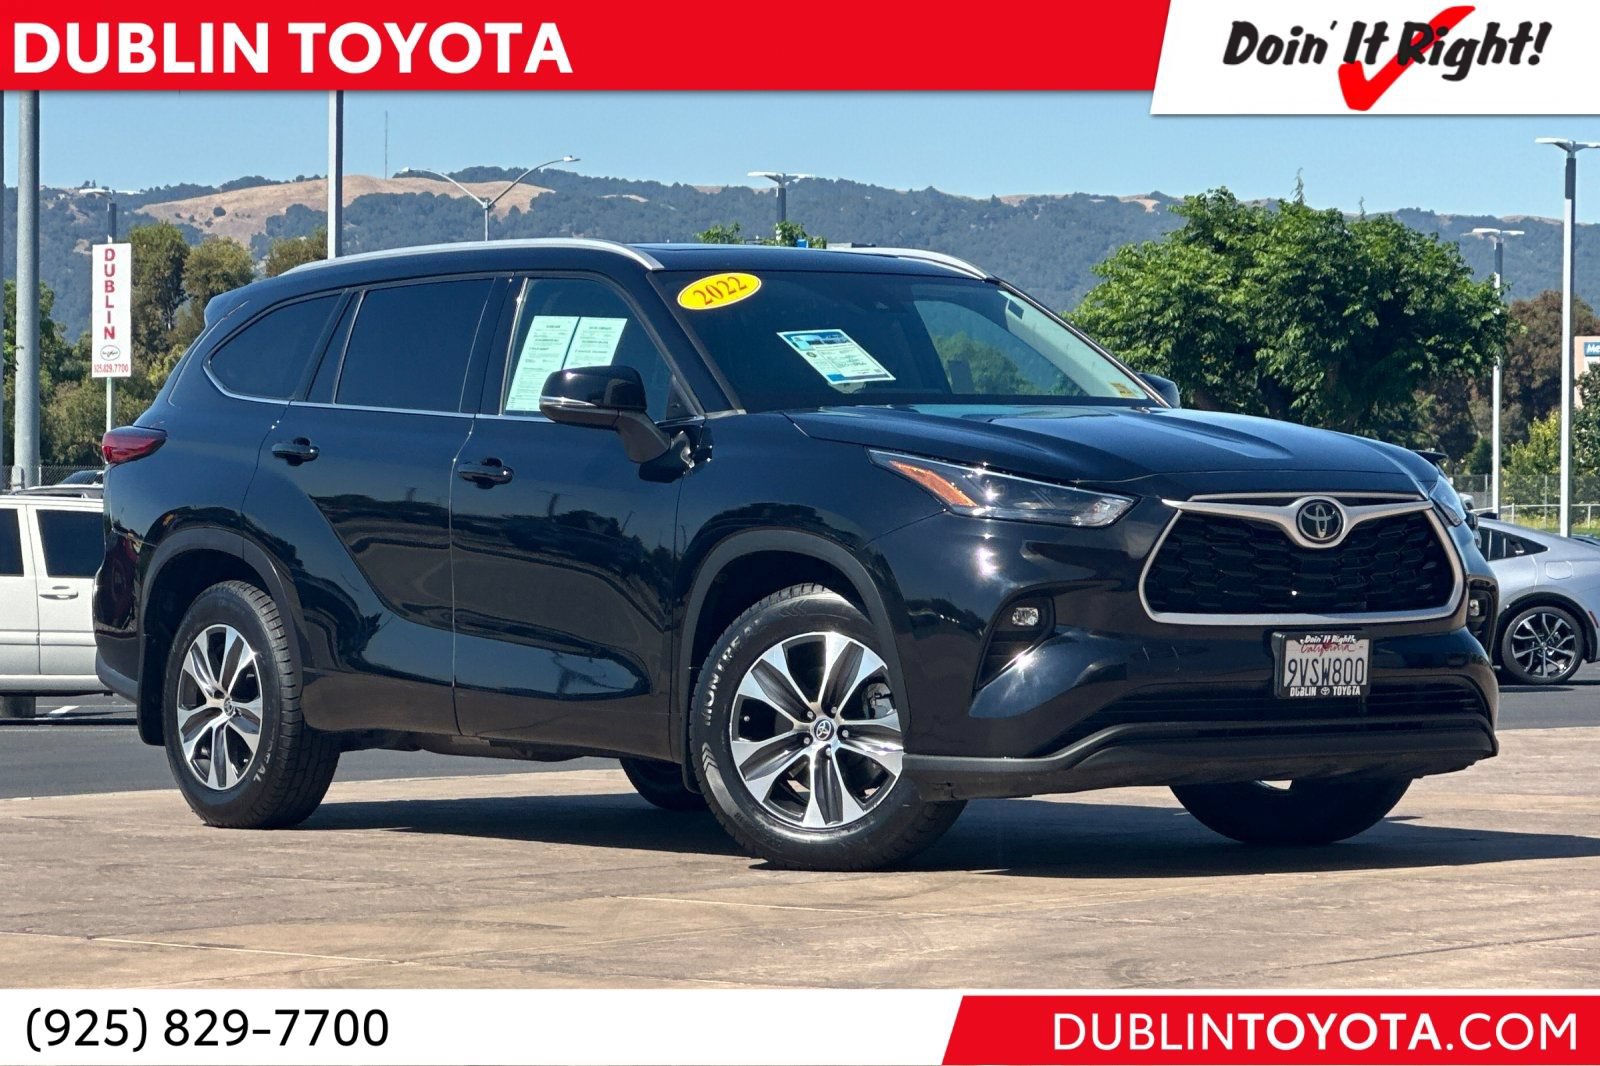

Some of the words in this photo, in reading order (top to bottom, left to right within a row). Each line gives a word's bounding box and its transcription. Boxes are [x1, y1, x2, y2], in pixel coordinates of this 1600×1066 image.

[104, 248, 116, 340] DUBLIN
[693, 276, 748, 306] 2022
[1286, 657, 1365, 687] 9VSW800
[1289, 686, 1317, 697] DUBLIN
[1333, 685, 1361, 696] TOYOTA
